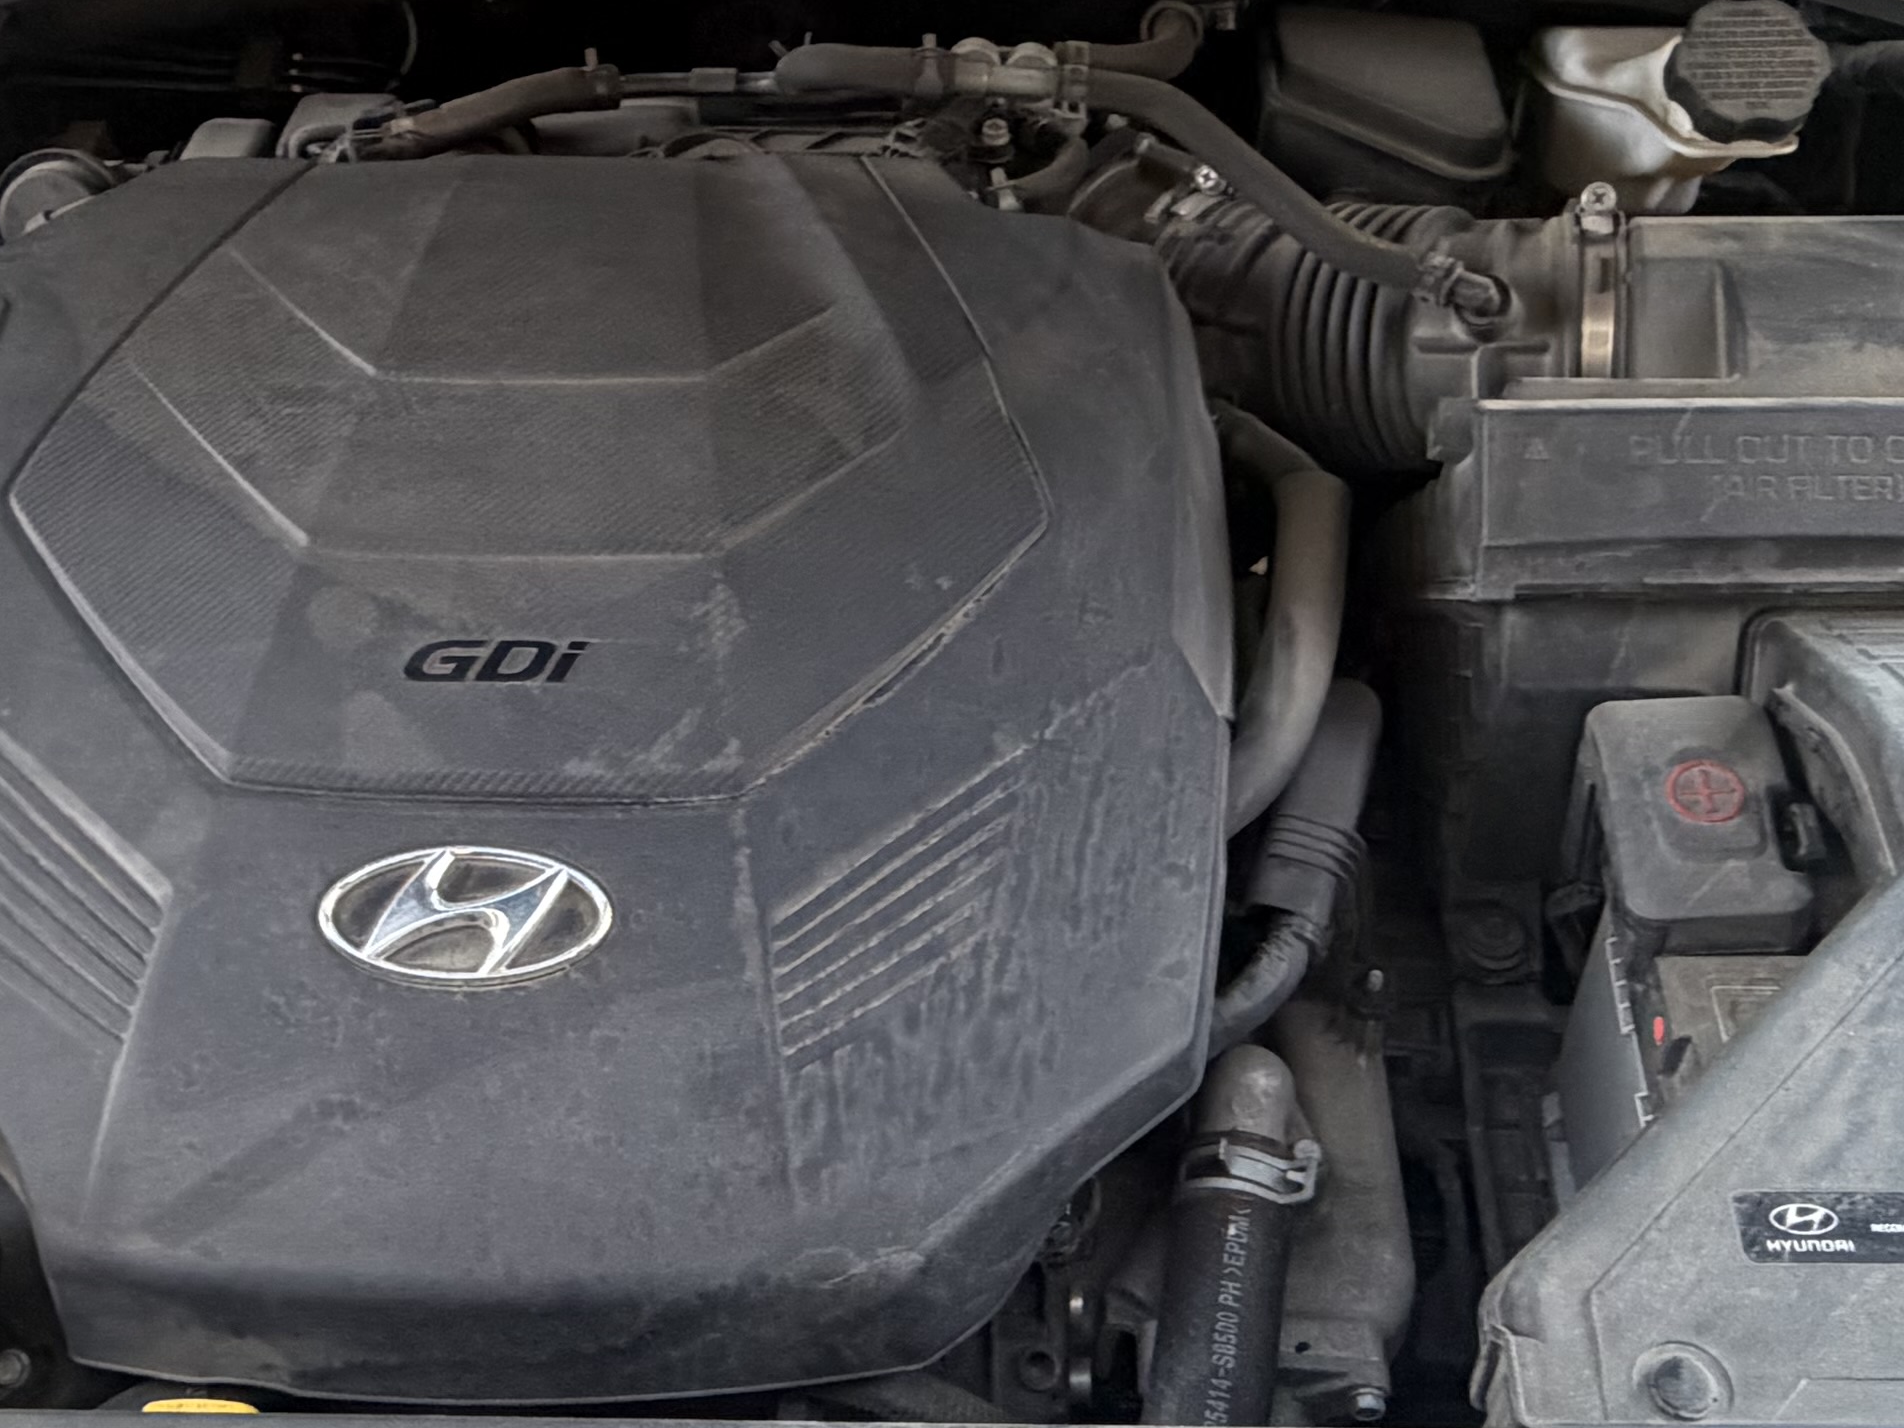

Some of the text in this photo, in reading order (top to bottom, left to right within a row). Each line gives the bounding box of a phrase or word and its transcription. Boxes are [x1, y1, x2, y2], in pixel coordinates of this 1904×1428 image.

[1629, 434, 1726, 463] PULL
[1736, 435, 1810, 463] OUT
[1823, 435, 1871, 463] TO
[403, 639, 590, 682] GDi
[1766, 1239, 1855, 1252] HYUNDAI
[1216, 1279, 1243, 1308] PH
